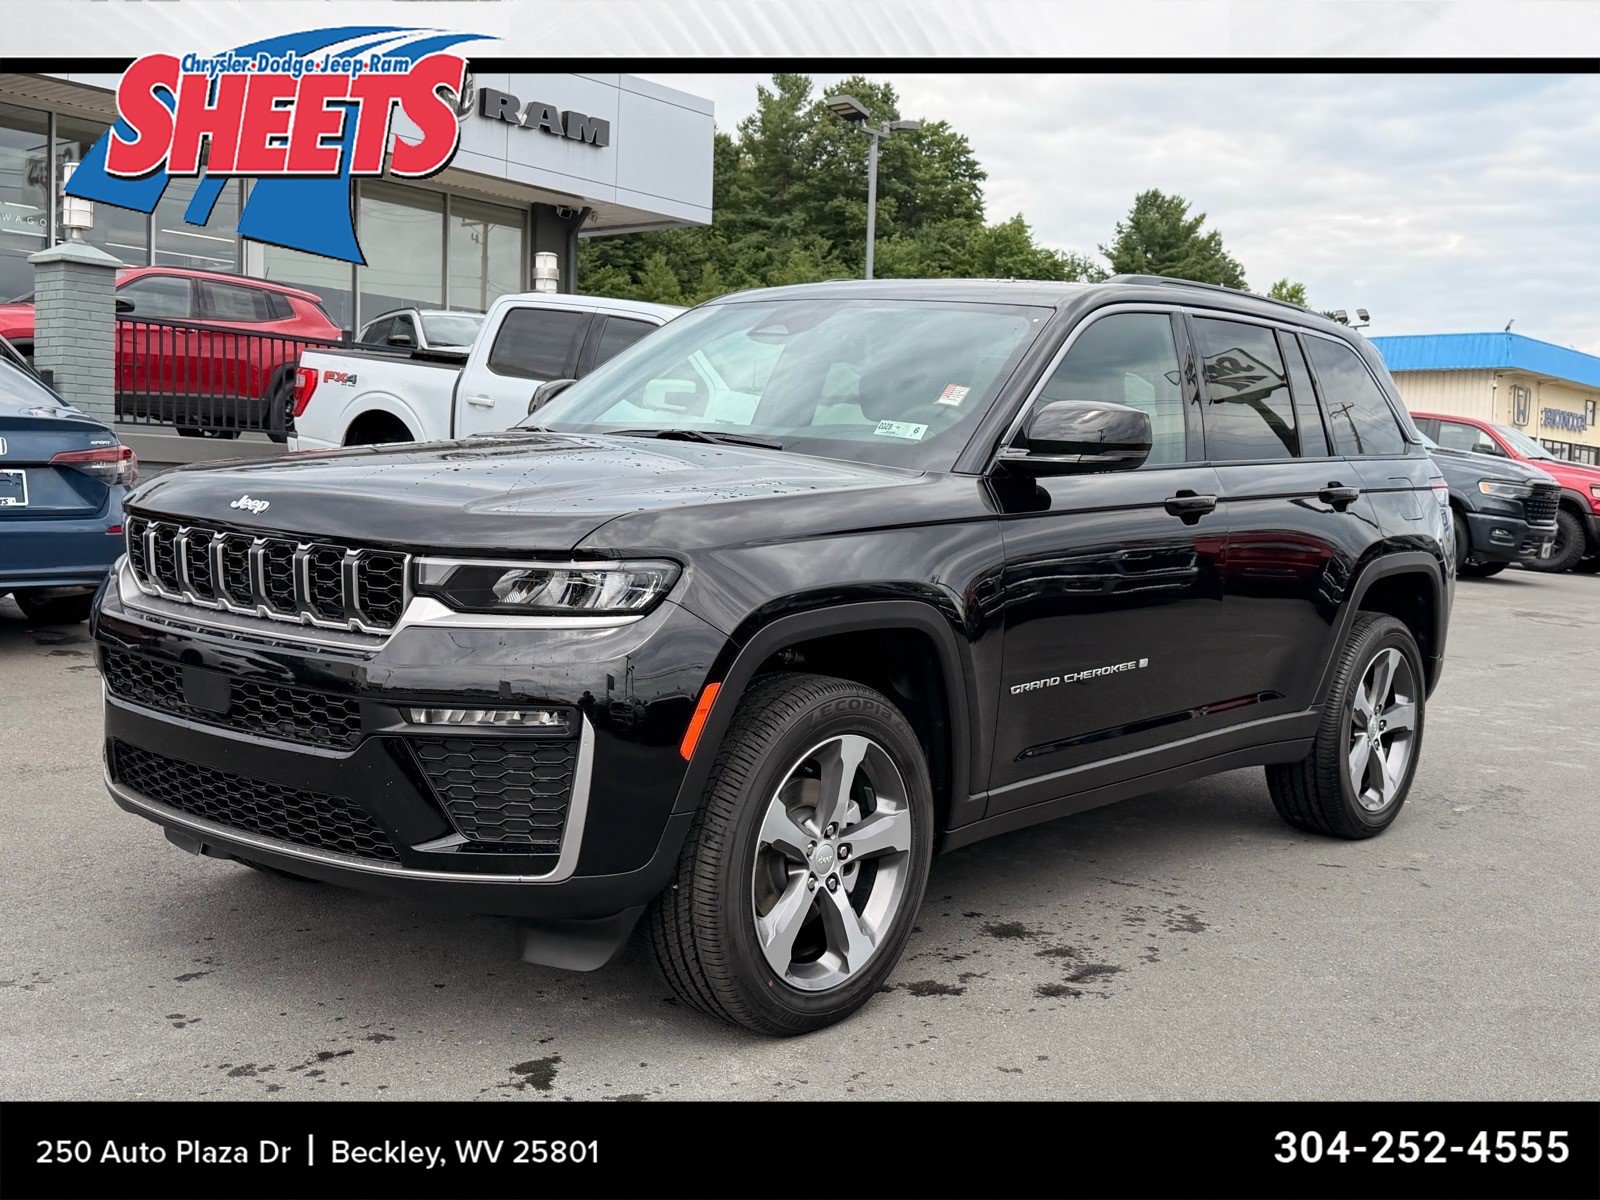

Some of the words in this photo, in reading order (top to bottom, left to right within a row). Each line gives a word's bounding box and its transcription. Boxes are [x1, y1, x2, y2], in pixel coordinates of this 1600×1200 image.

[479, 87, 610, 147] RAM
[323, 370, 357, 385] FX4
[230, 495, 270, 515] Jeep
[1010, 677, 1061, 695] GRAND
[1064, 661, 1137, 683] CHEROKEE
